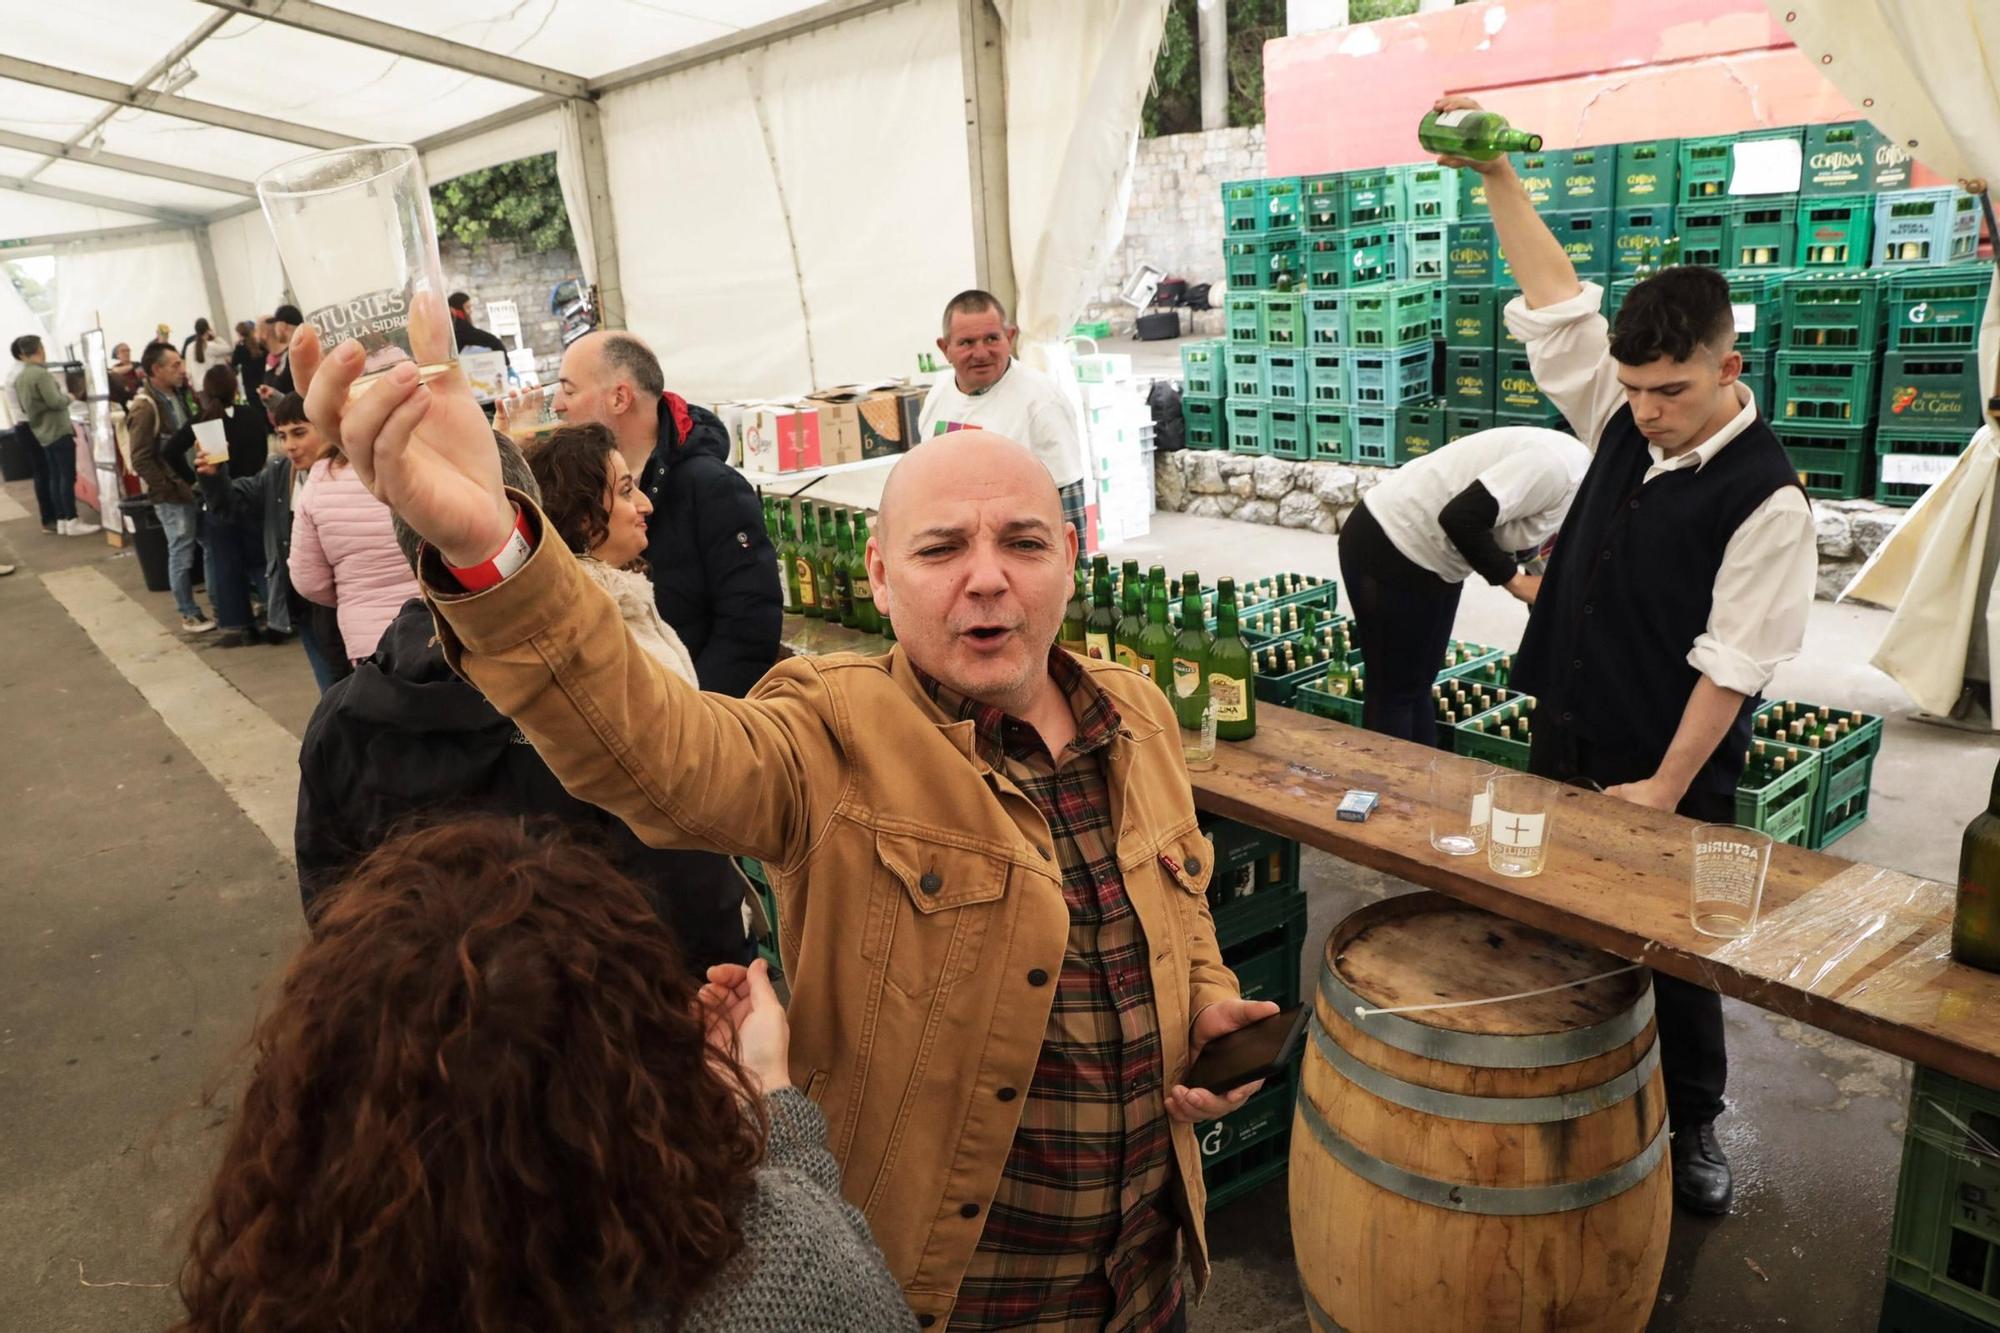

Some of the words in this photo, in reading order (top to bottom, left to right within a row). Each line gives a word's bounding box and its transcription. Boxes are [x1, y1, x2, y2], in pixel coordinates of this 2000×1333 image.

[307, 291, 405, 337] STURIES
[353, 326, 370, 338] LA
[1491, 842, 1541, 857] ASTURIES
